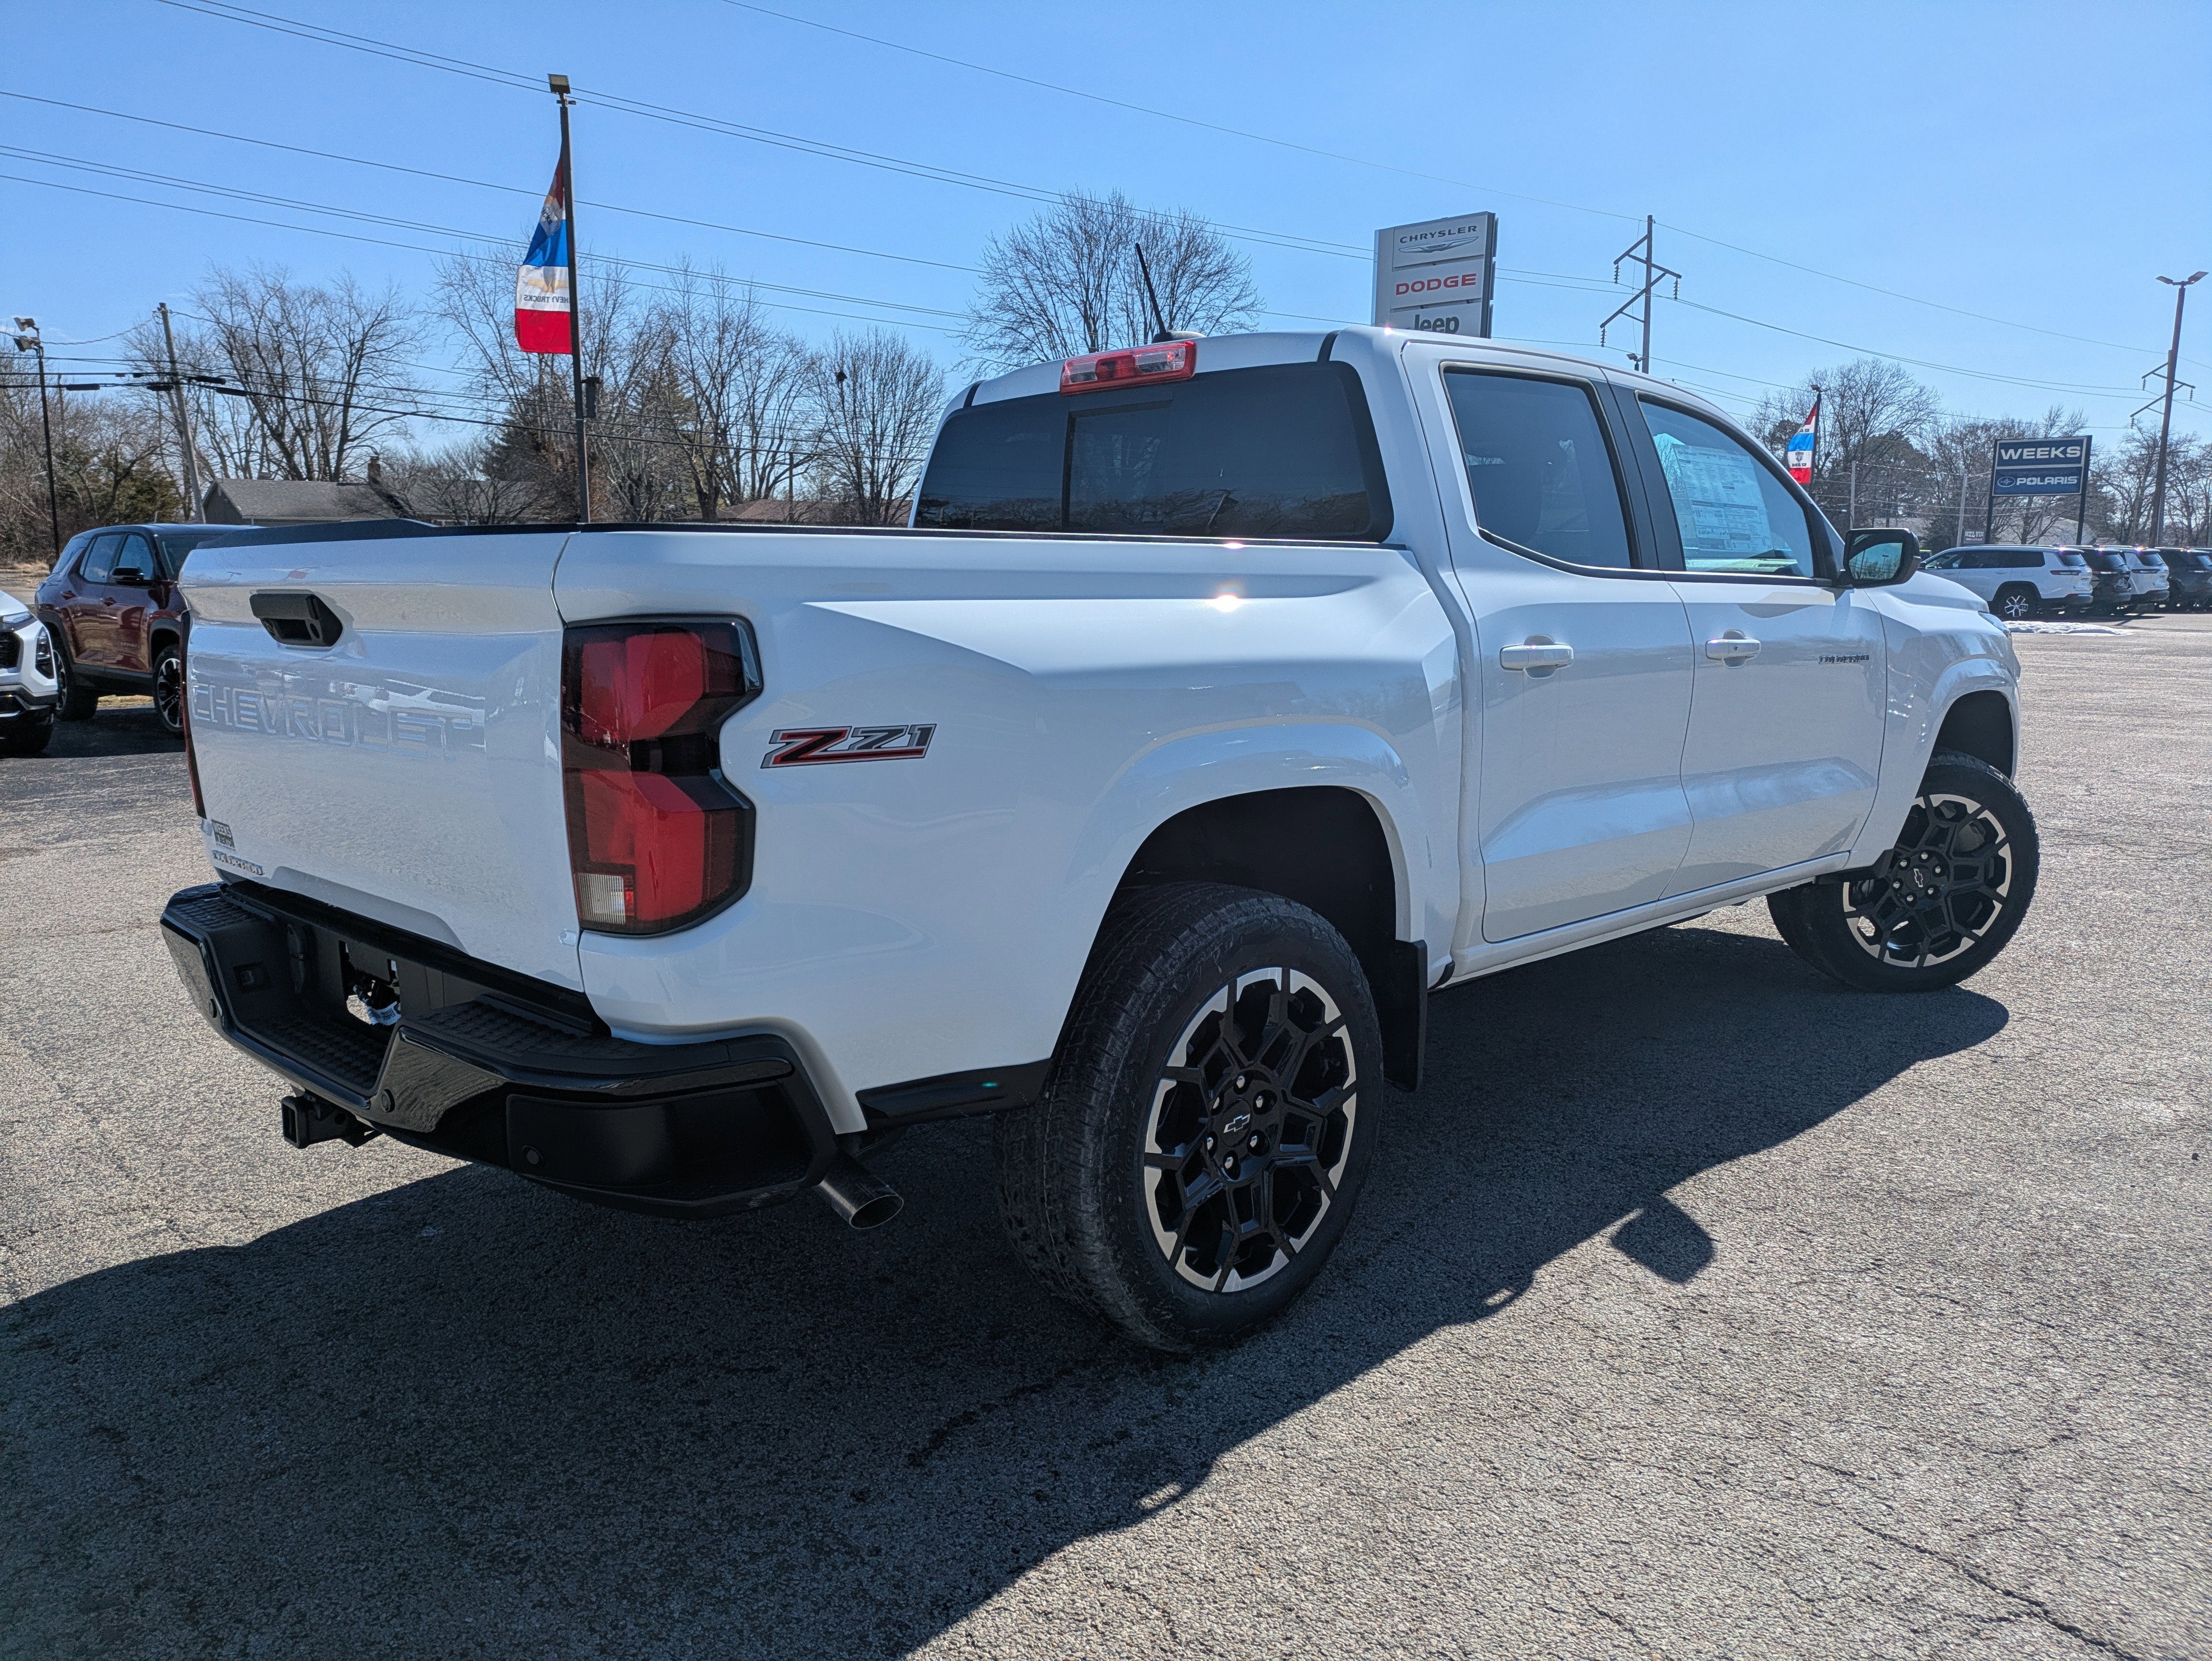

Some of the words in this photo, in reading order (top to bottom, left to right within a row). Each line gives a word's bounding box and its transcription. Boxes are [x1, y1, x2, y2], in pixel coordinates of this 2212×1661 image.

[1400, 225, 1477, 244] CHRYSLER
[1395, 273, 1477, 296] DODGE
[2000, 446, 2080, 460] WEEKS
[2016, 476, 2078, 486] POLARIS
[192, 682, 473, 761] CHEVROLET
[760, 723, 937, 769] Z71
